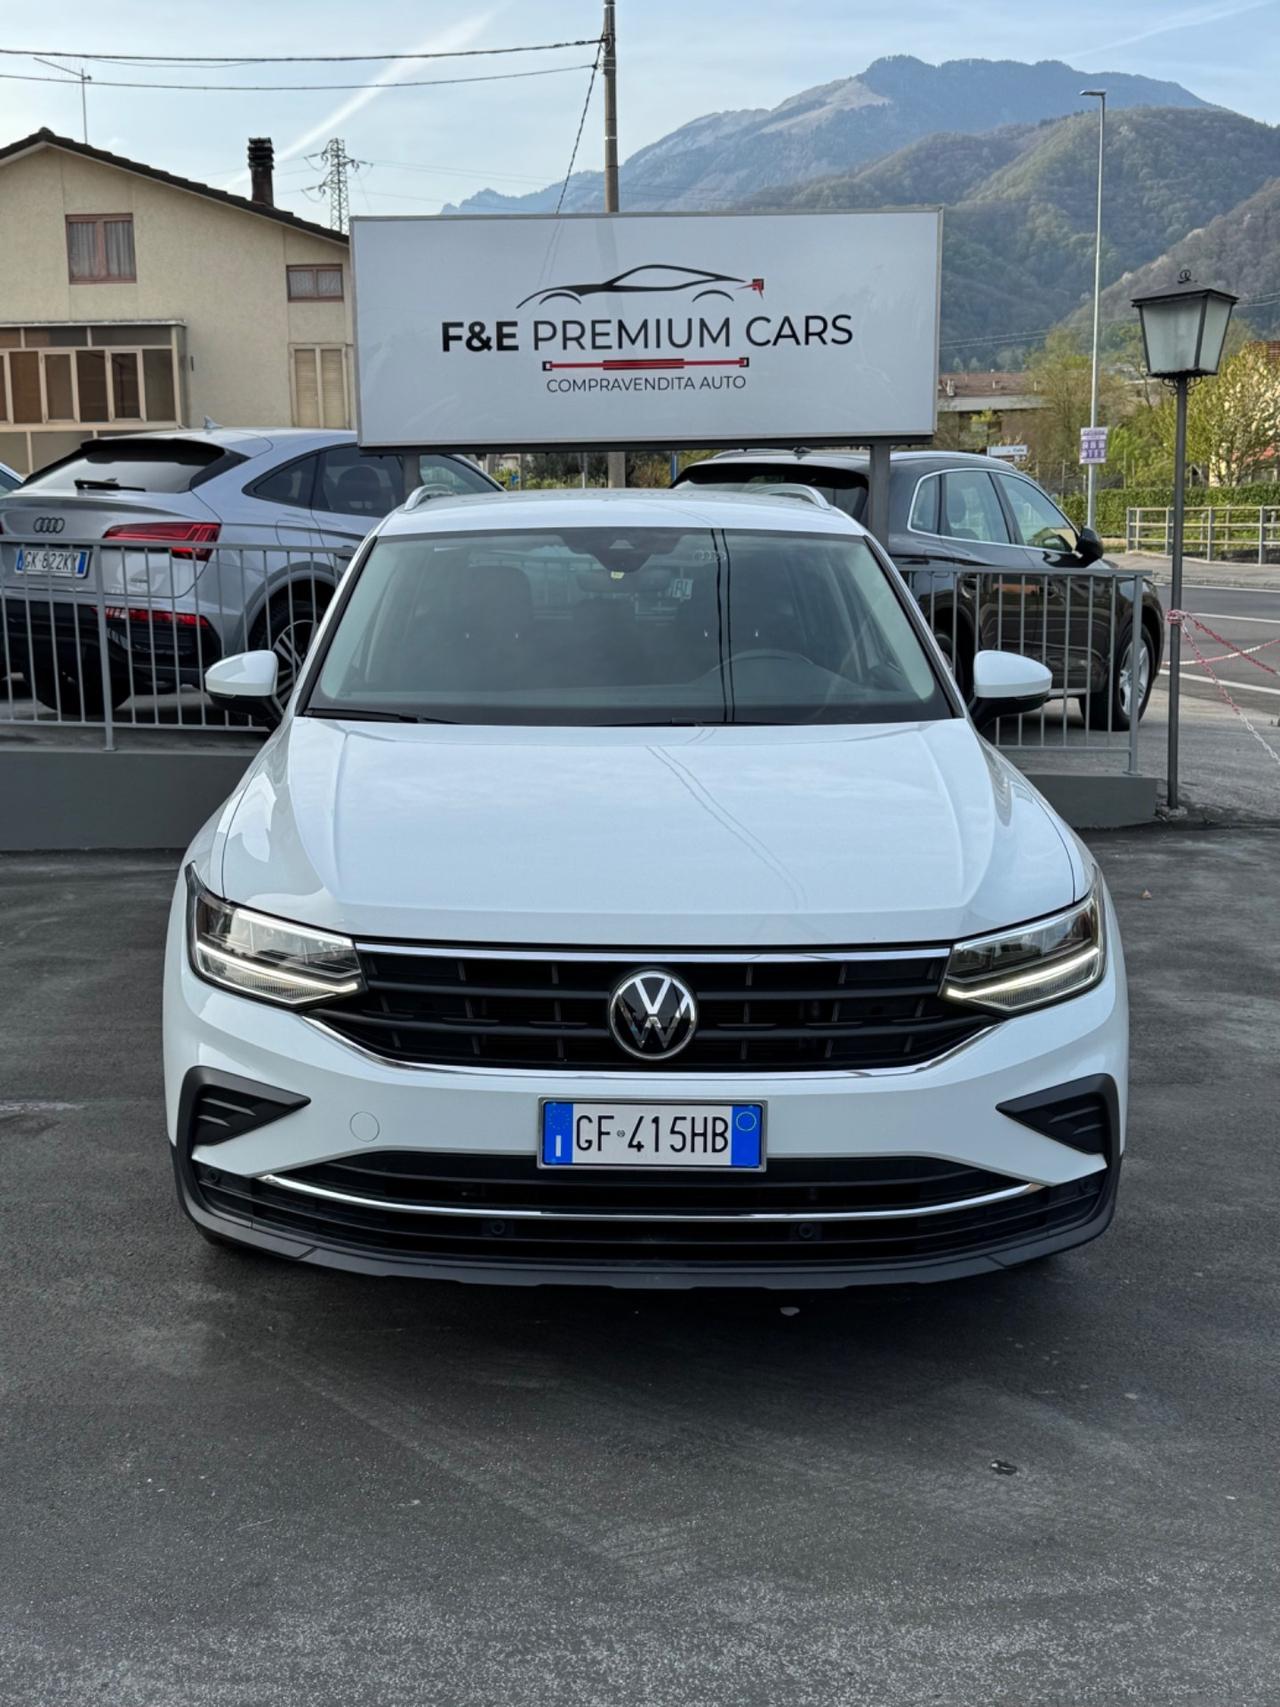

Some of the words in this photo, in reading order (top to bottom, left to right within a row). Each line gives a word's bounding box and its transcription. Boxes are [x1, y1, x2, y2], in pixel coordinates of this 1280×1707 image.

[442, 320, 519, 352] F&E
[532, 317, 731, 350] PREMIUM
[745, 314, 854, 347] CARS
[546, 376, 696, 393] COMPRAVENDITA
[699, 375, 747, 390] AUTO
